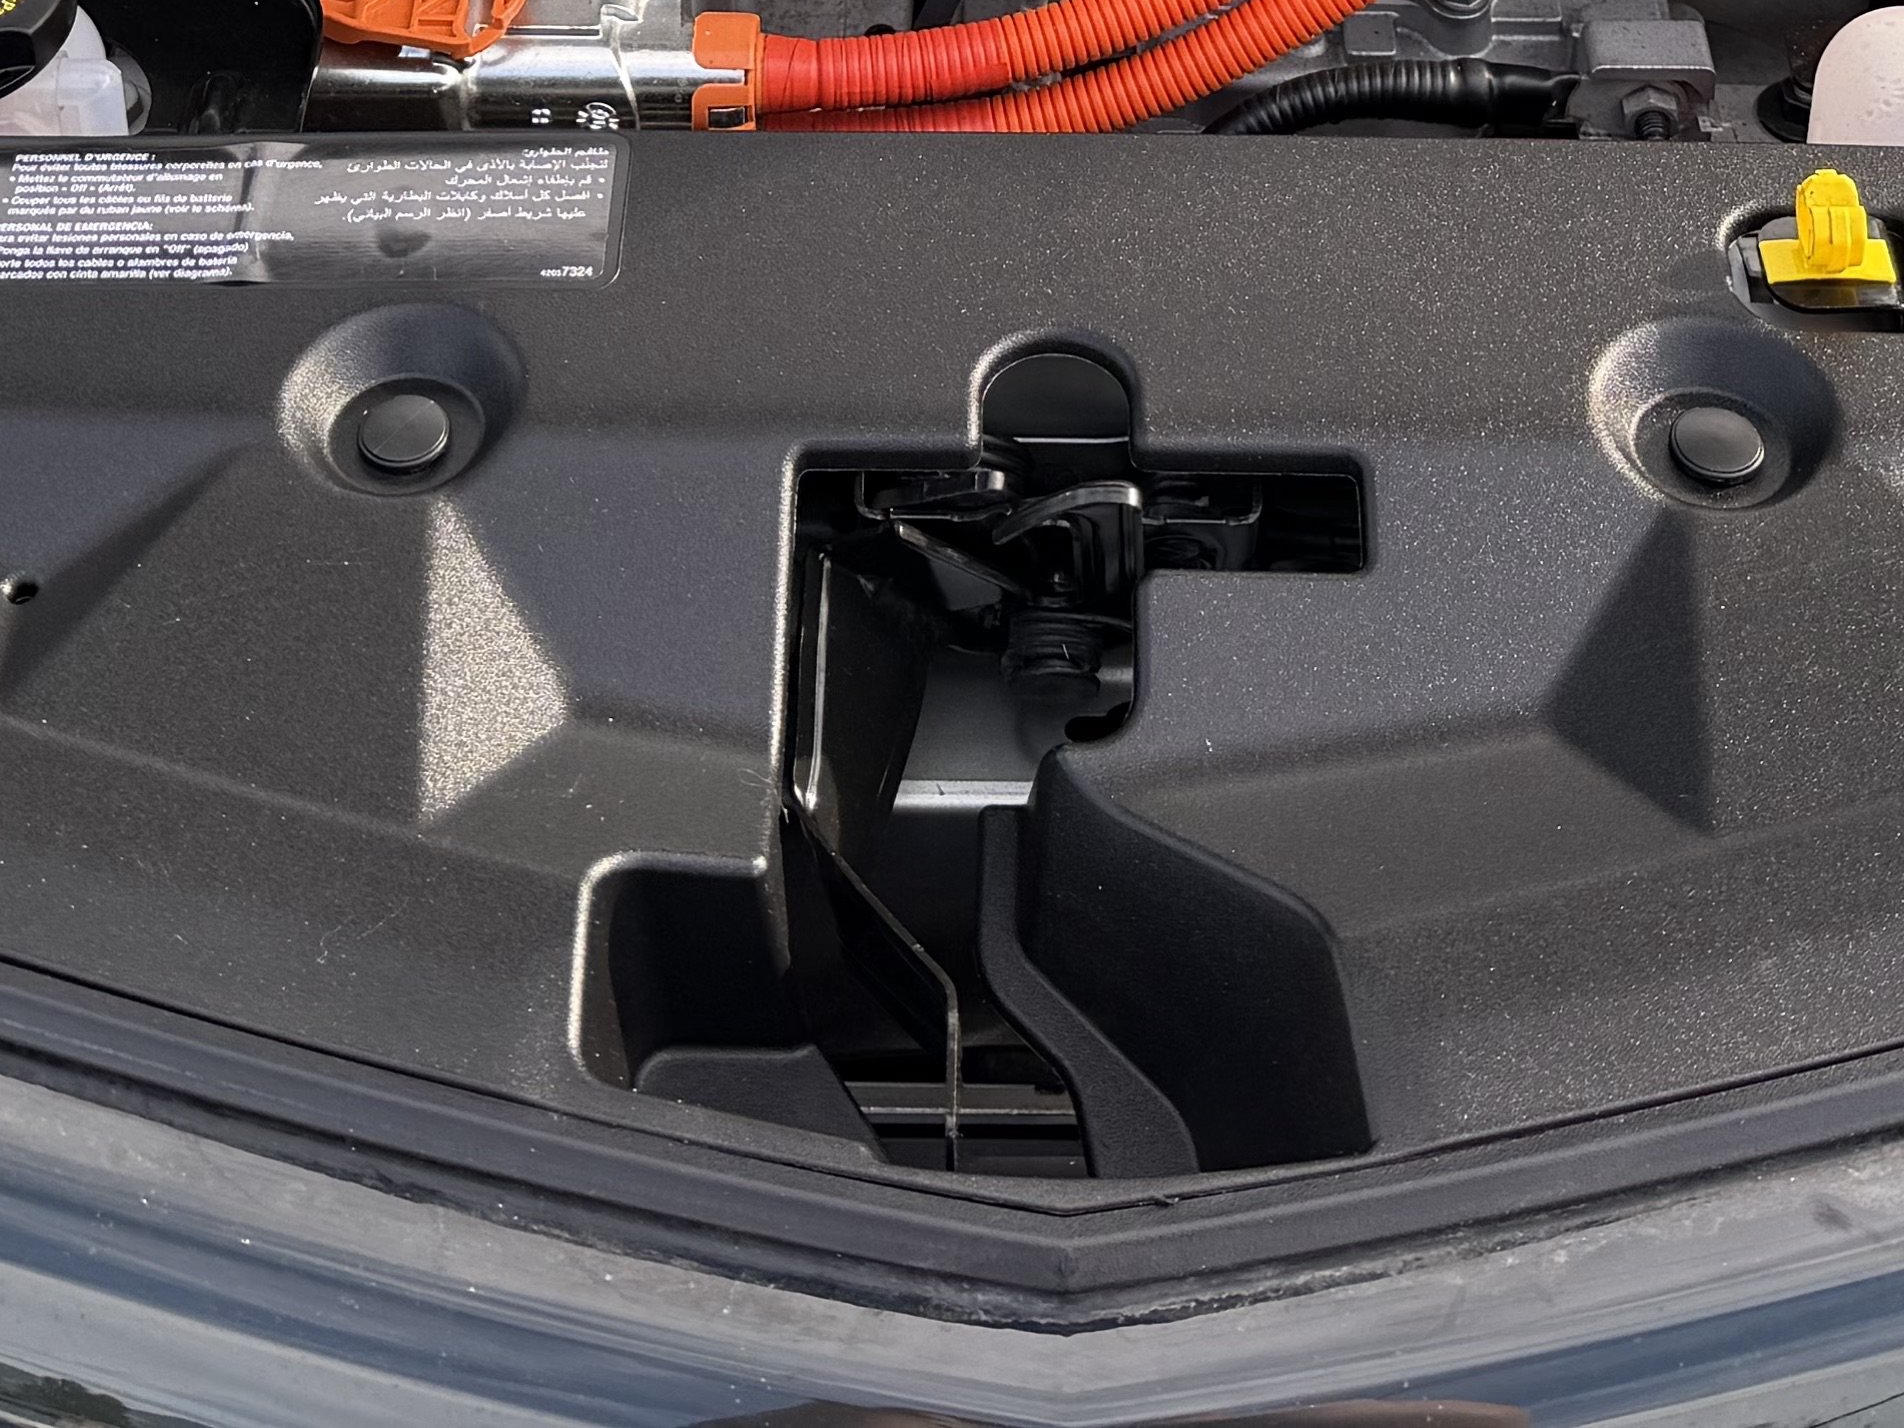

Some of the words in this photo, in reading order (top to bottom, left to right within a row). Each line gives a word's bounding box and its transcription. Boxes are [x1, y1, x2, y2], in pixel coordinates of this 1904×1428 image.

[15, 154, 82, 162] PERSONNEL
[84, 154, 149, 162] D'URGENCE
[11, 162, 37, 172] Pour
[74, 162, 107, 171] toutes
[244, 160, 263, 170] cas
[18, 173, 56, 183] Mettez
[72, 173, 145, 183] commutateur
[14, 184, 58, 195] position
[11, 196, 51, 205] Couper
[56, 222, 72, 232] DE
[74, 222, 154, 232] EMERGENCIA:
[17, 234, 49, 243] evitar
[52, 233, 98, 243] lesiones
[99, 233, 161, 242] personales
[180, 232, 207, 242] caso
[25, 258, 55, 268] todos
[58, 258, 75, 268] los
[77, 258, 114, 268] cables
[127, 257, 178, 267] alambres
[46, 269, 67, 279] con
[148, 268, 170, 278] (ver
